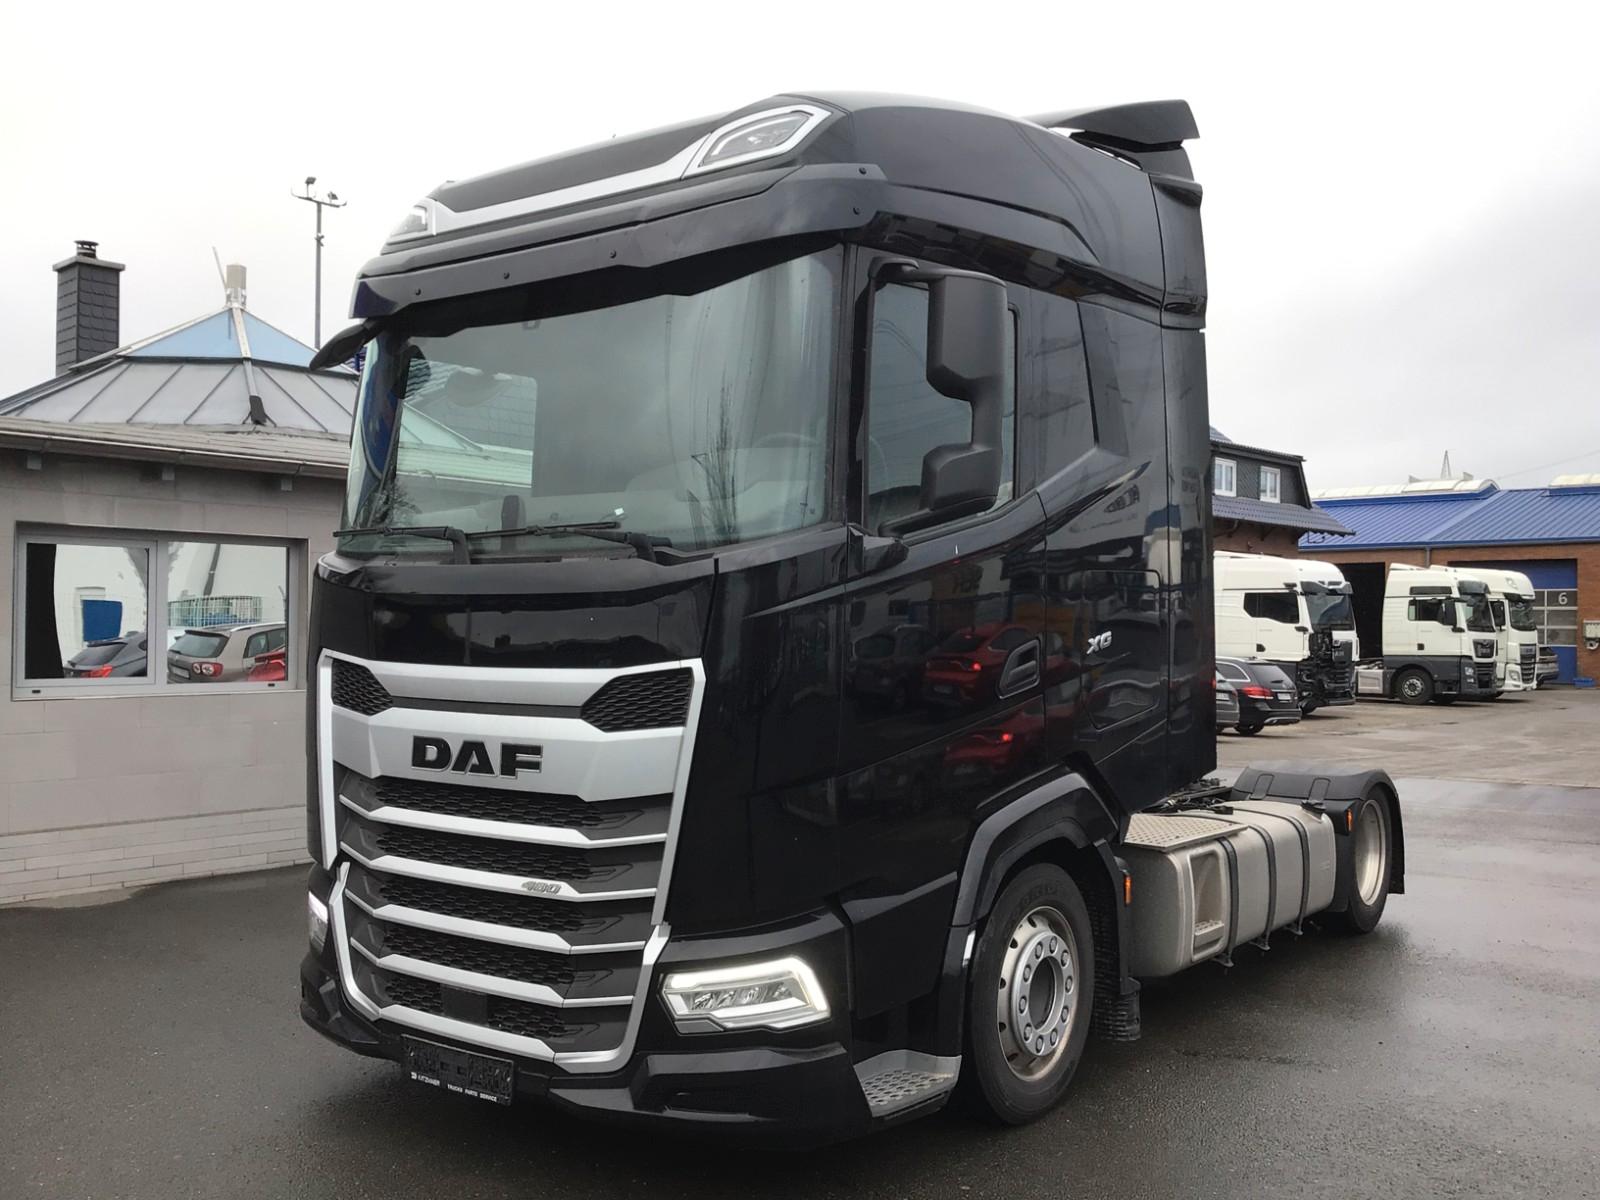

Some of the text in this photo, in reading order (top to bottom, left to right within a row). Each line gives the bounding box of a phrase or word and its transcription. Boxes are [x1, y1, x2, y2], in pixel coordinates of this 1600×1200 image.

[1558, 592, 1568, 605] 6
[1086, 630, 1112, 655] XG
[411, 735, 543, 779] DAF
